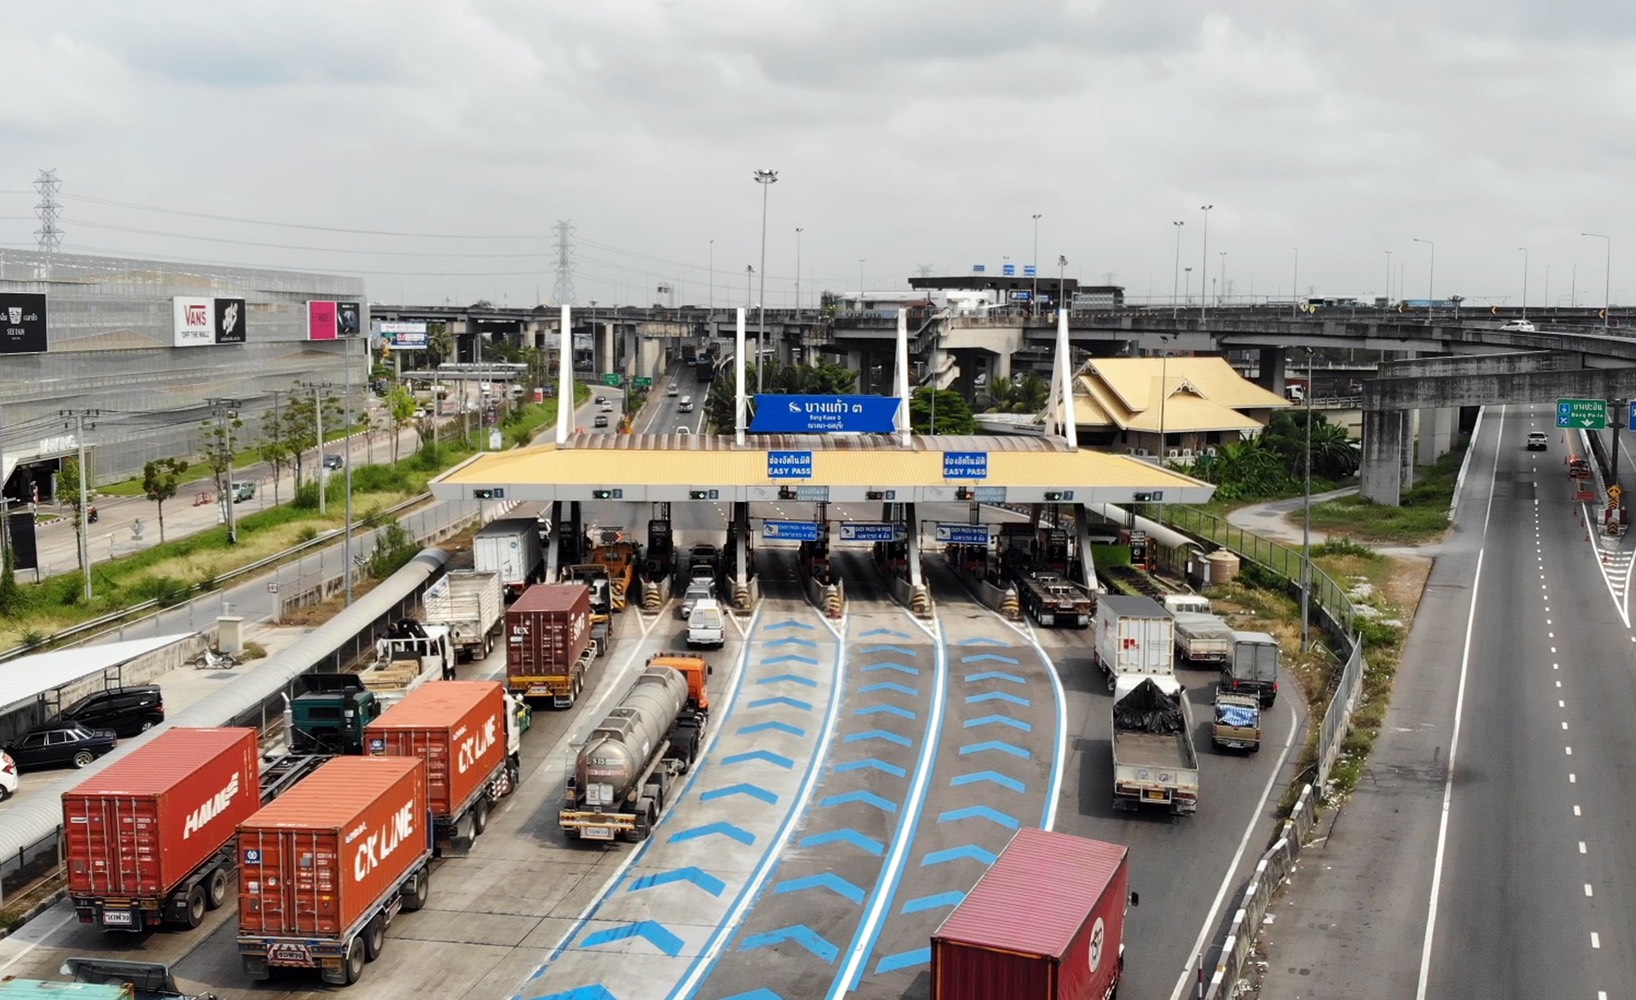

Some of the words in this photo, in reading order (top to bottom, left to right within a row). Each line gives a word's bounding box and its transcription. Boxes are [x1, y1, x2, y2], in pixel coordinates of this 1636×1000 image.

[184, 305, 206, 326] VANS
[805, 399, 848, 413] บางแก้ว
[768, 467, 789, 475] EASY
[458, 736, 474, 774] CK
[475, 714, 496, 760] LINE
[354, 830, 378, 882] CK
[380, 798, 414, 860] LINE
